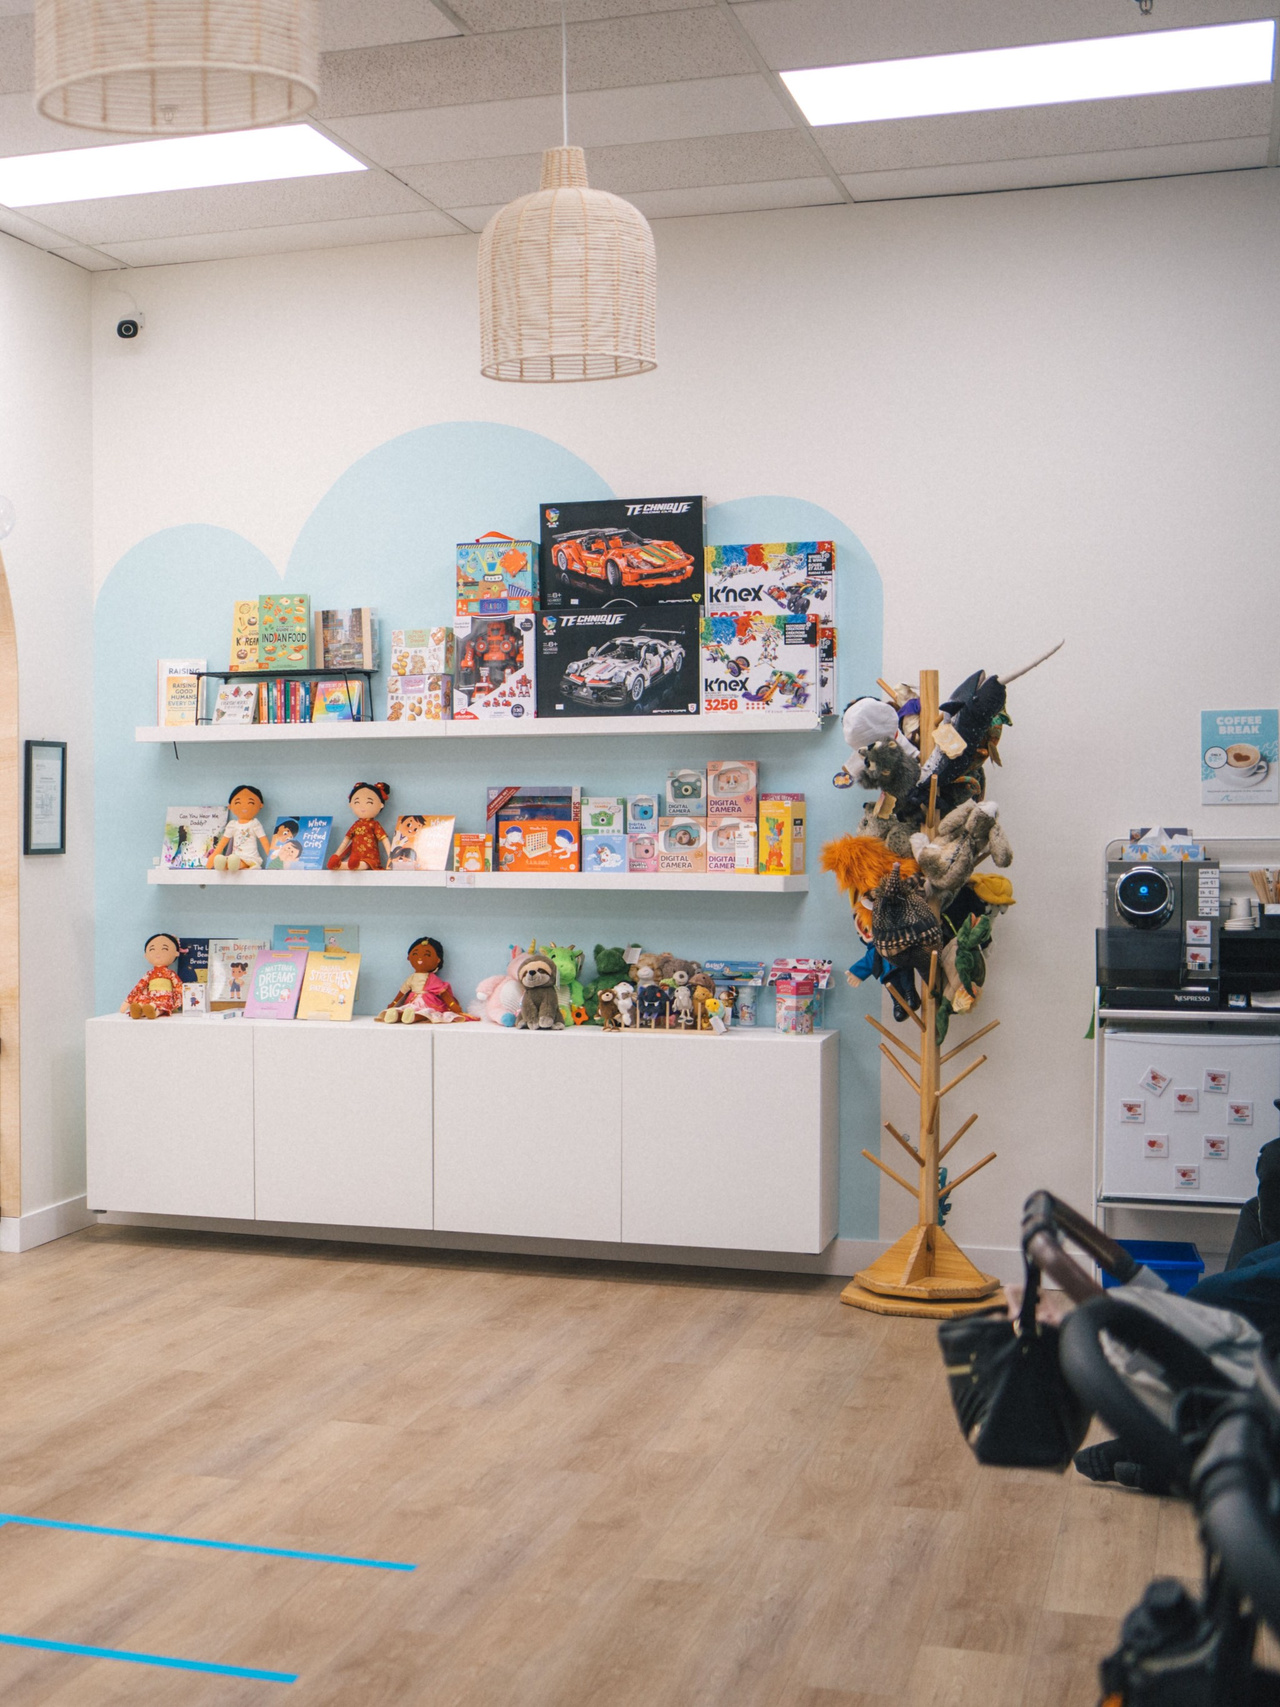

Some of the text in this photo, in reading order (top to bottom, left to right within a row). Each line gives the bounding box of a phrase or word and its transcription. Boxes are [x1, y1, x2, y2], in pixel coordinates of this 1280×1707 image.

[624, 501, 695, 517] TECHNIQUE
[558, 612, 628, 628] TECHNIQUE
[288, 632, 308, 643] FOOD
[172, 682, 198, 690] RAISING
[167, 699, 188, 707] EVERY
[1215, 715, 1263, 726] COFFEE
[1218, 725, 1261, 736] BREAK
[709, 798, 739, 807] DIGITAL
[709, 805, 743, 814] CAMERA
[178, 812, 188, 820] Can
[188, 812, 199, 820] You
[307, 817, 328, 828] When
[302, 831, 328, 841] Friend
[660, 855, 689, 863] DIGITAL
[660, 862, 693, 870] CAMERA
[708, 862, 736, 870] CAMER
[193, 944, 205, 952] The
[232, 941, 267, 952] Different
[257, 971, 296, 988] DREAMS
[259, 982, 281, 1001] BIG
[1173, 993, 1211, 1003] NESPRESSO
